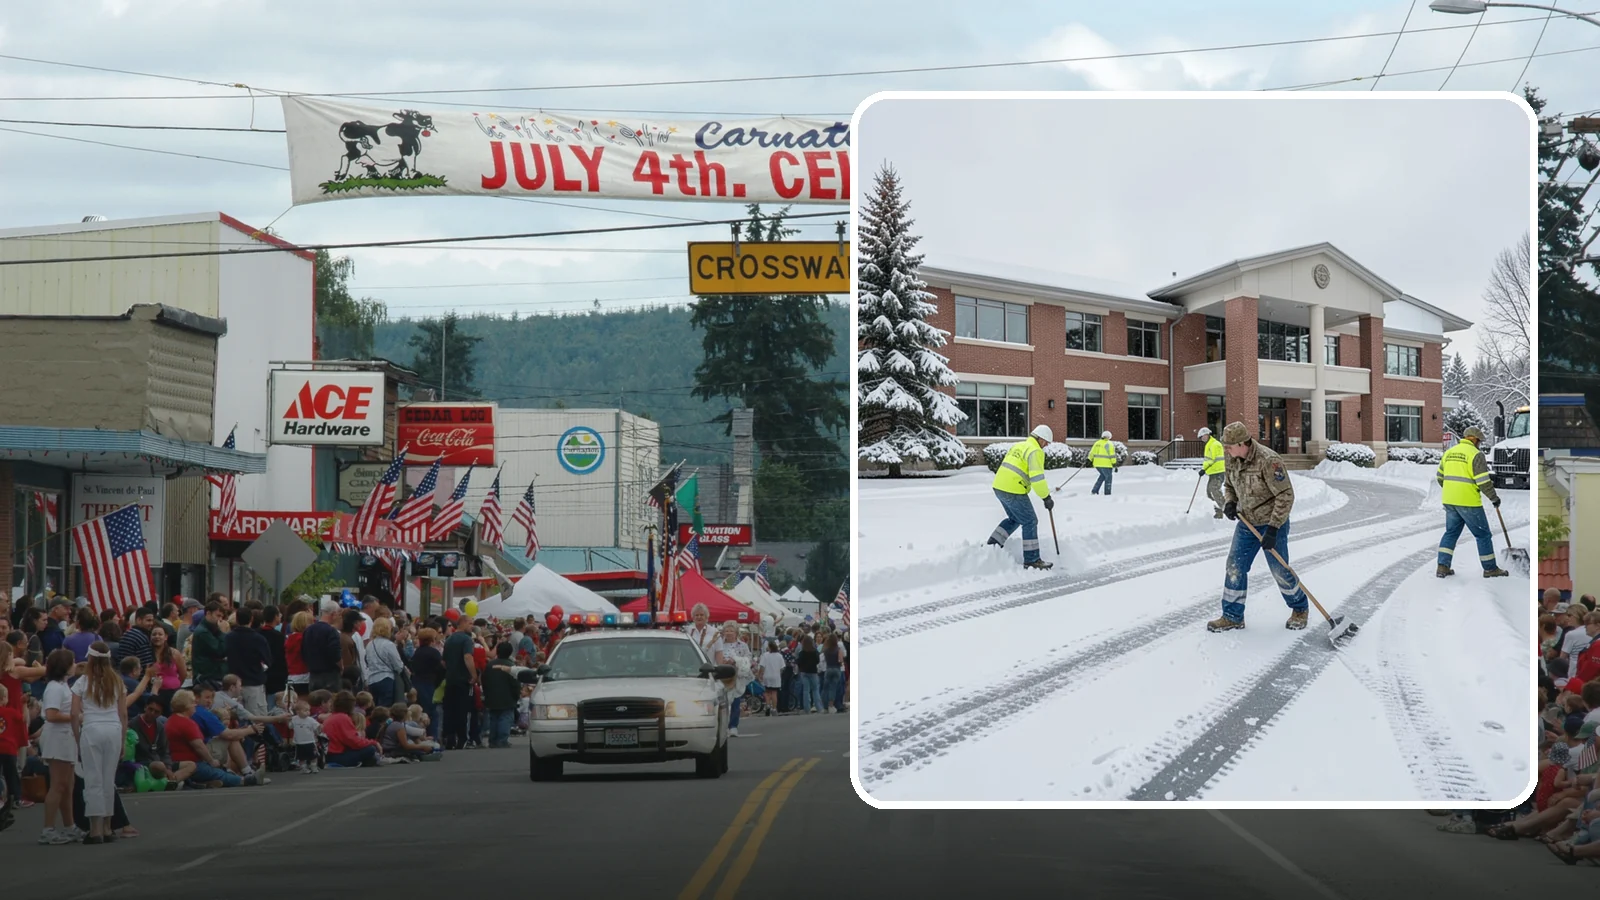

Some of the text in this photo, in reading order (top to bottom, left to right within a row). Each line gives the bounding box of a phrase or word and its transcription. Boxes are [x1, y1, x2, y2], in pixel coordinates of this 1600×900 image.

[695, 121, 850, 150] Carnat
[481, 141, 605, 193] JULY
[632, 150, 746, 198] 4th.
[697, 254, 850, 280] CROSSWA
[282, 380, 374, 420] ACE
[405, 409, 452, 422] CEDAR
[283, 421, 371, 436] Hardware
[416, 428, 477, 447] Coca-Cola
[353, 467, 385, 480] Simpl
[82, 485, 155, 495] St. Vincent de Paul
[81, 503, 154, 522] THT
[212, 515, 331, 536] HARDARE
[688, 526, 741, 535] CRNATION
[699, 535, 730, 543] GLASS
